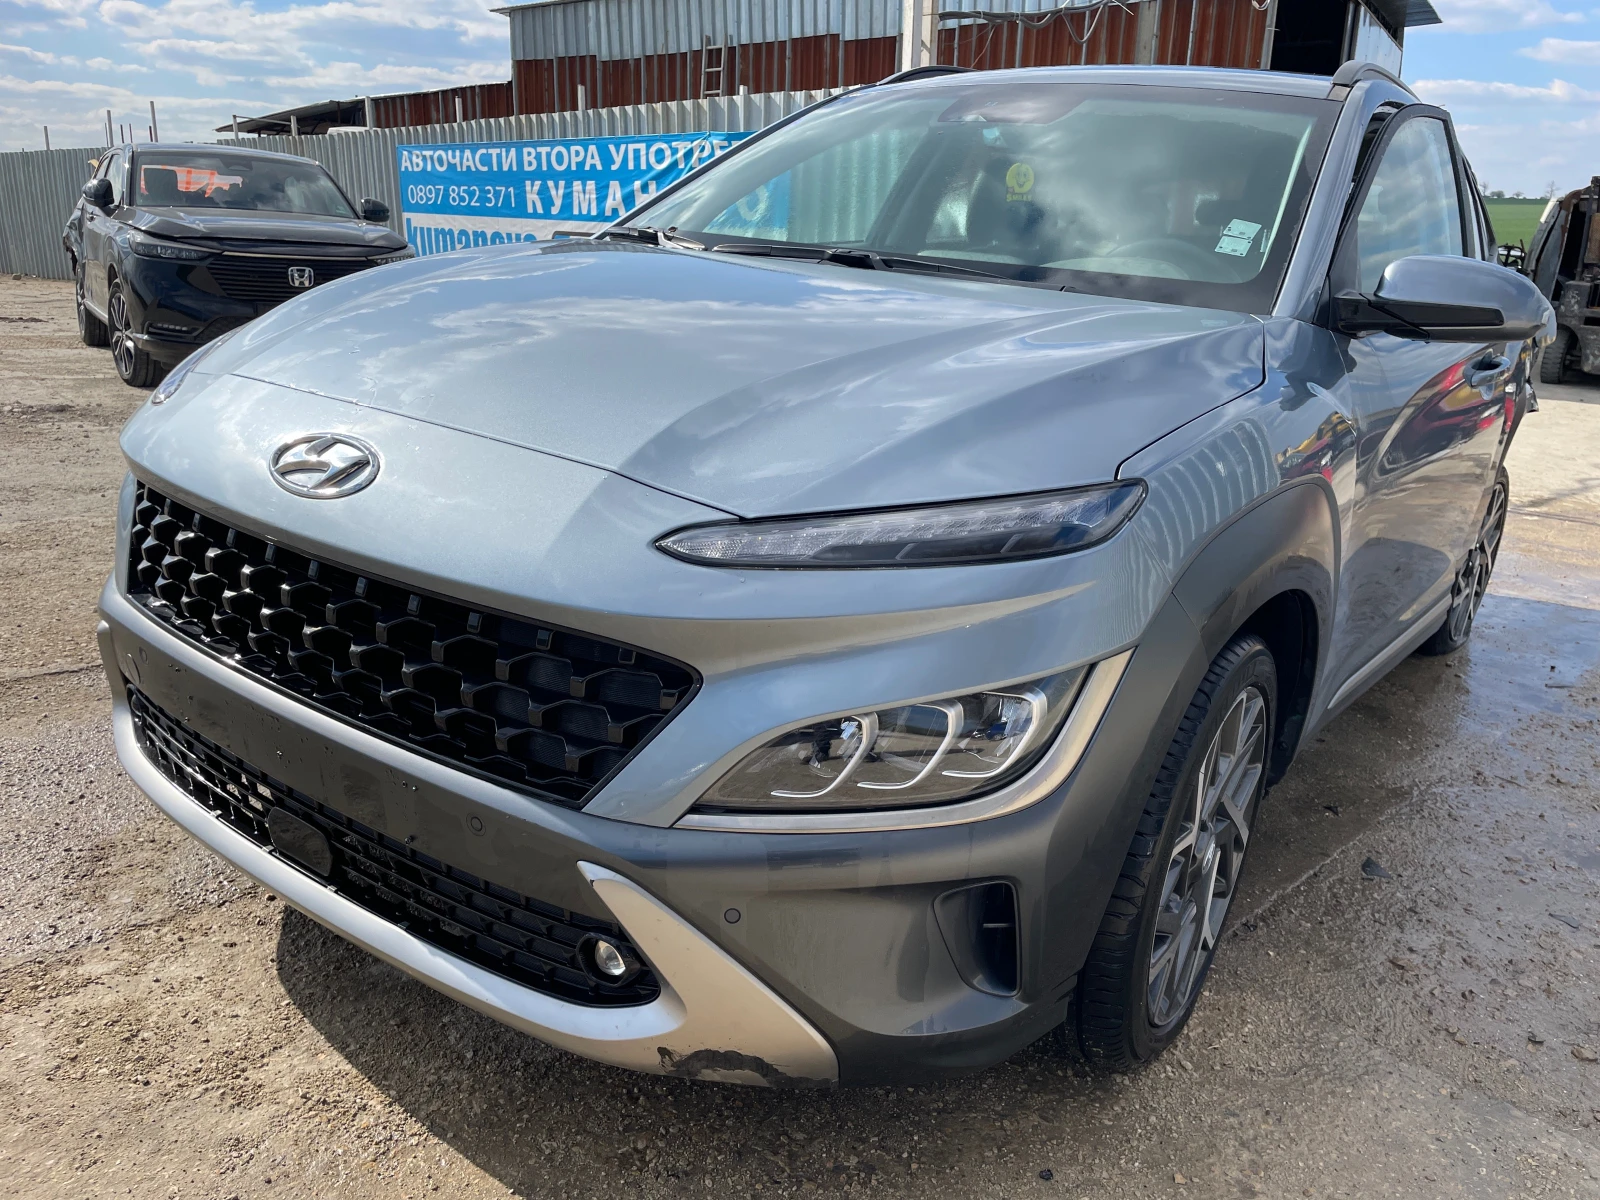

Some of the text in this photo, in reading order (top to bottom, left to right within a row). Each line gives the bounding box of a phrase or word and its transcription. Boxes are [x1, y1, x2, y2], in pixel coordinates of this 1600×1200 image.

[401, 148, 517, 172] АВТОЧАСТИ
[522, 145, 603, 172] ВТОРА
[407, 184, 515, 208] 0897 852 371
